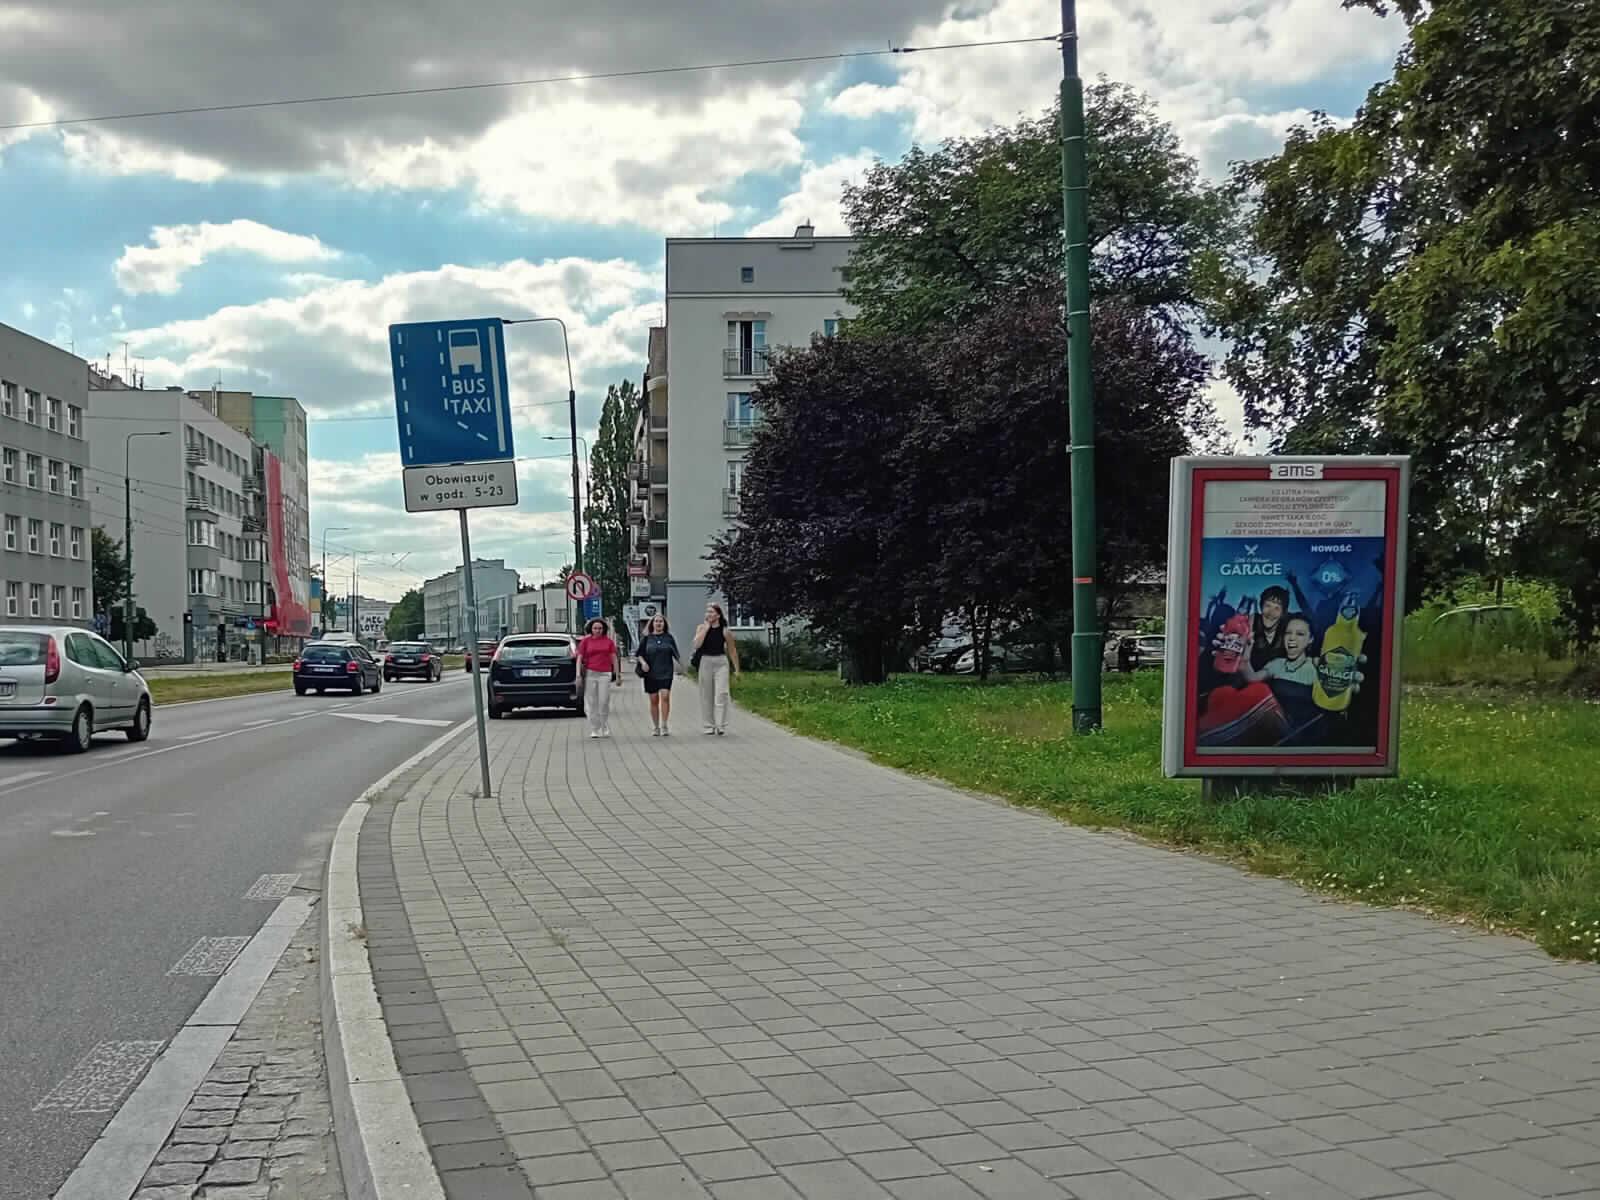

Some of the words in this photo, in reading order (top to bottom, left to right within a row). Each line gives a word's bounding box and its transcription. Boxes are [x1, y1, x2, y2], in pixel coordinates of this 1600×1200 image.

[452, 378, 486, 395] BUS
[449, 397, 491, 415] TAXI
[1278, 465, 1315, 477] ams
[425, 473, 495, 486] Obowiązuje
[420, 493, 429, 501] w
[475, 486, 503, 497] 5-23
[1220, 563, 1283, 576] GARAGE
[1319, 571, 1341, 583] 0%
